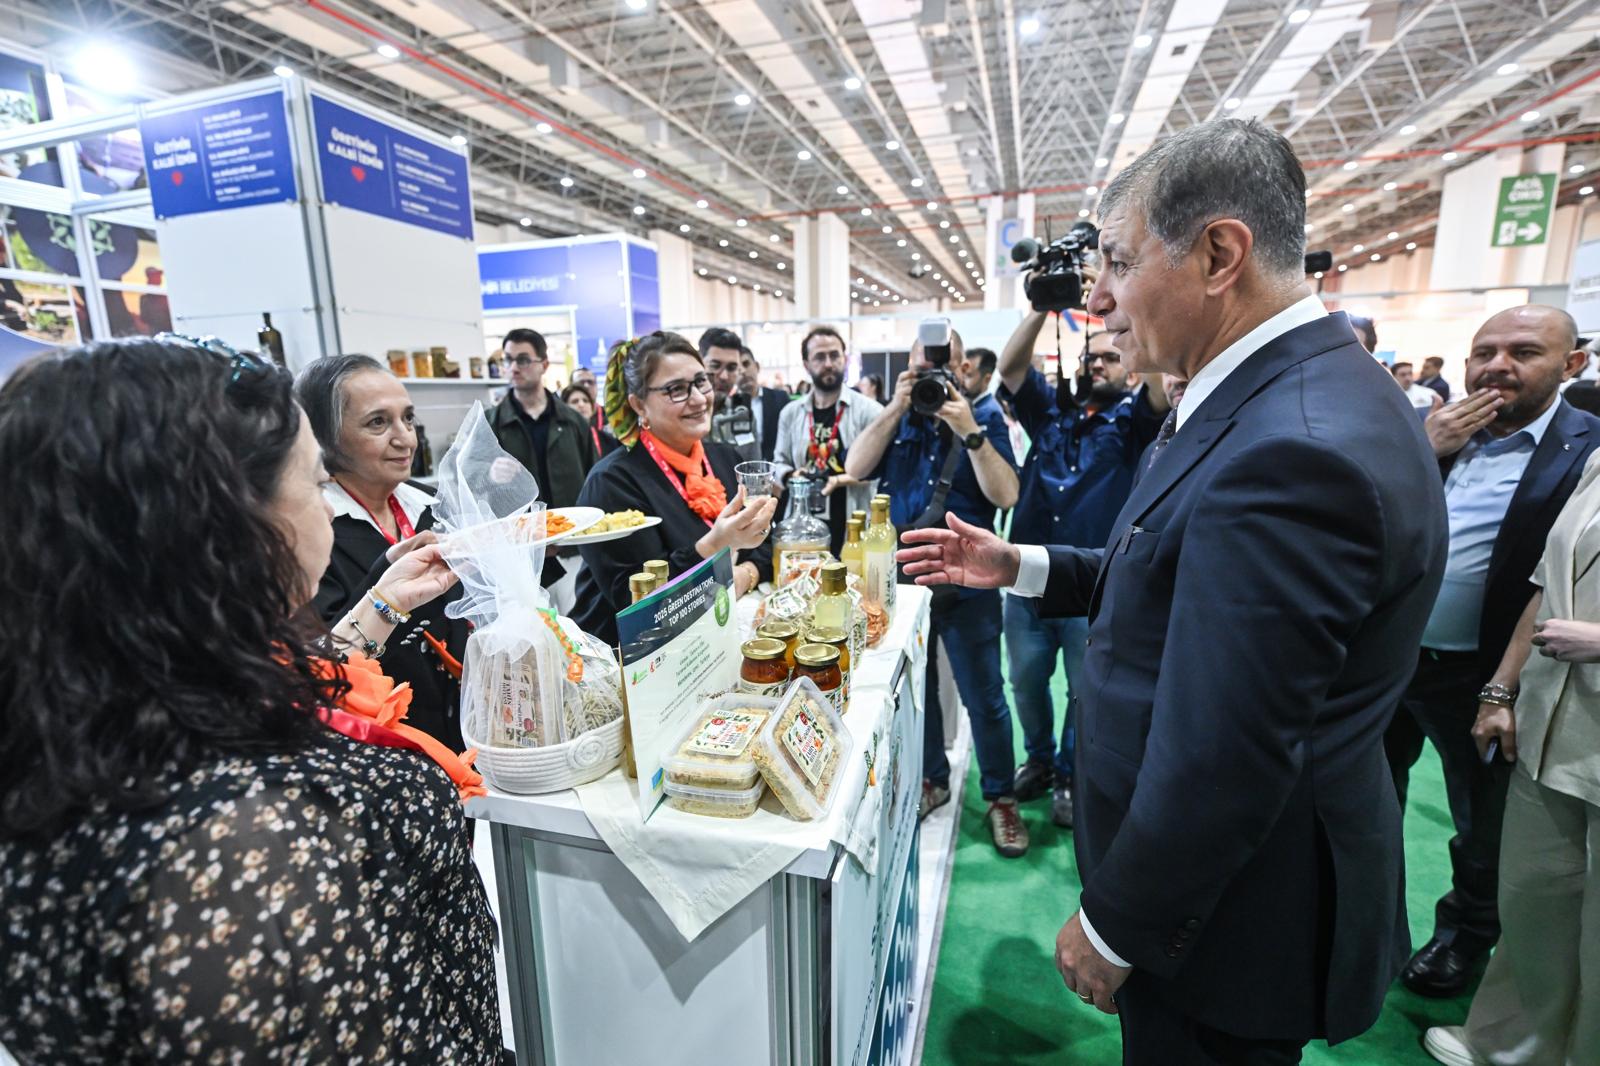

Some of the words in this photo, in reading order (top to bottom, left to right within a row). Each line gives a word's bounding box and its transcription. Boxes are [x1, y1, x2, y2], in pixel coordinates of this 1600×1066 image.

[654, 607, 668, 624] 2025
[667, 597, 684, 614] GREEN
[683, 576, 714, 605] DESTINATIONS
[668, 615, 680, 627] TOP
[680, 607, 688, 620] 100
[687, 594, 706, 614] STORIES
